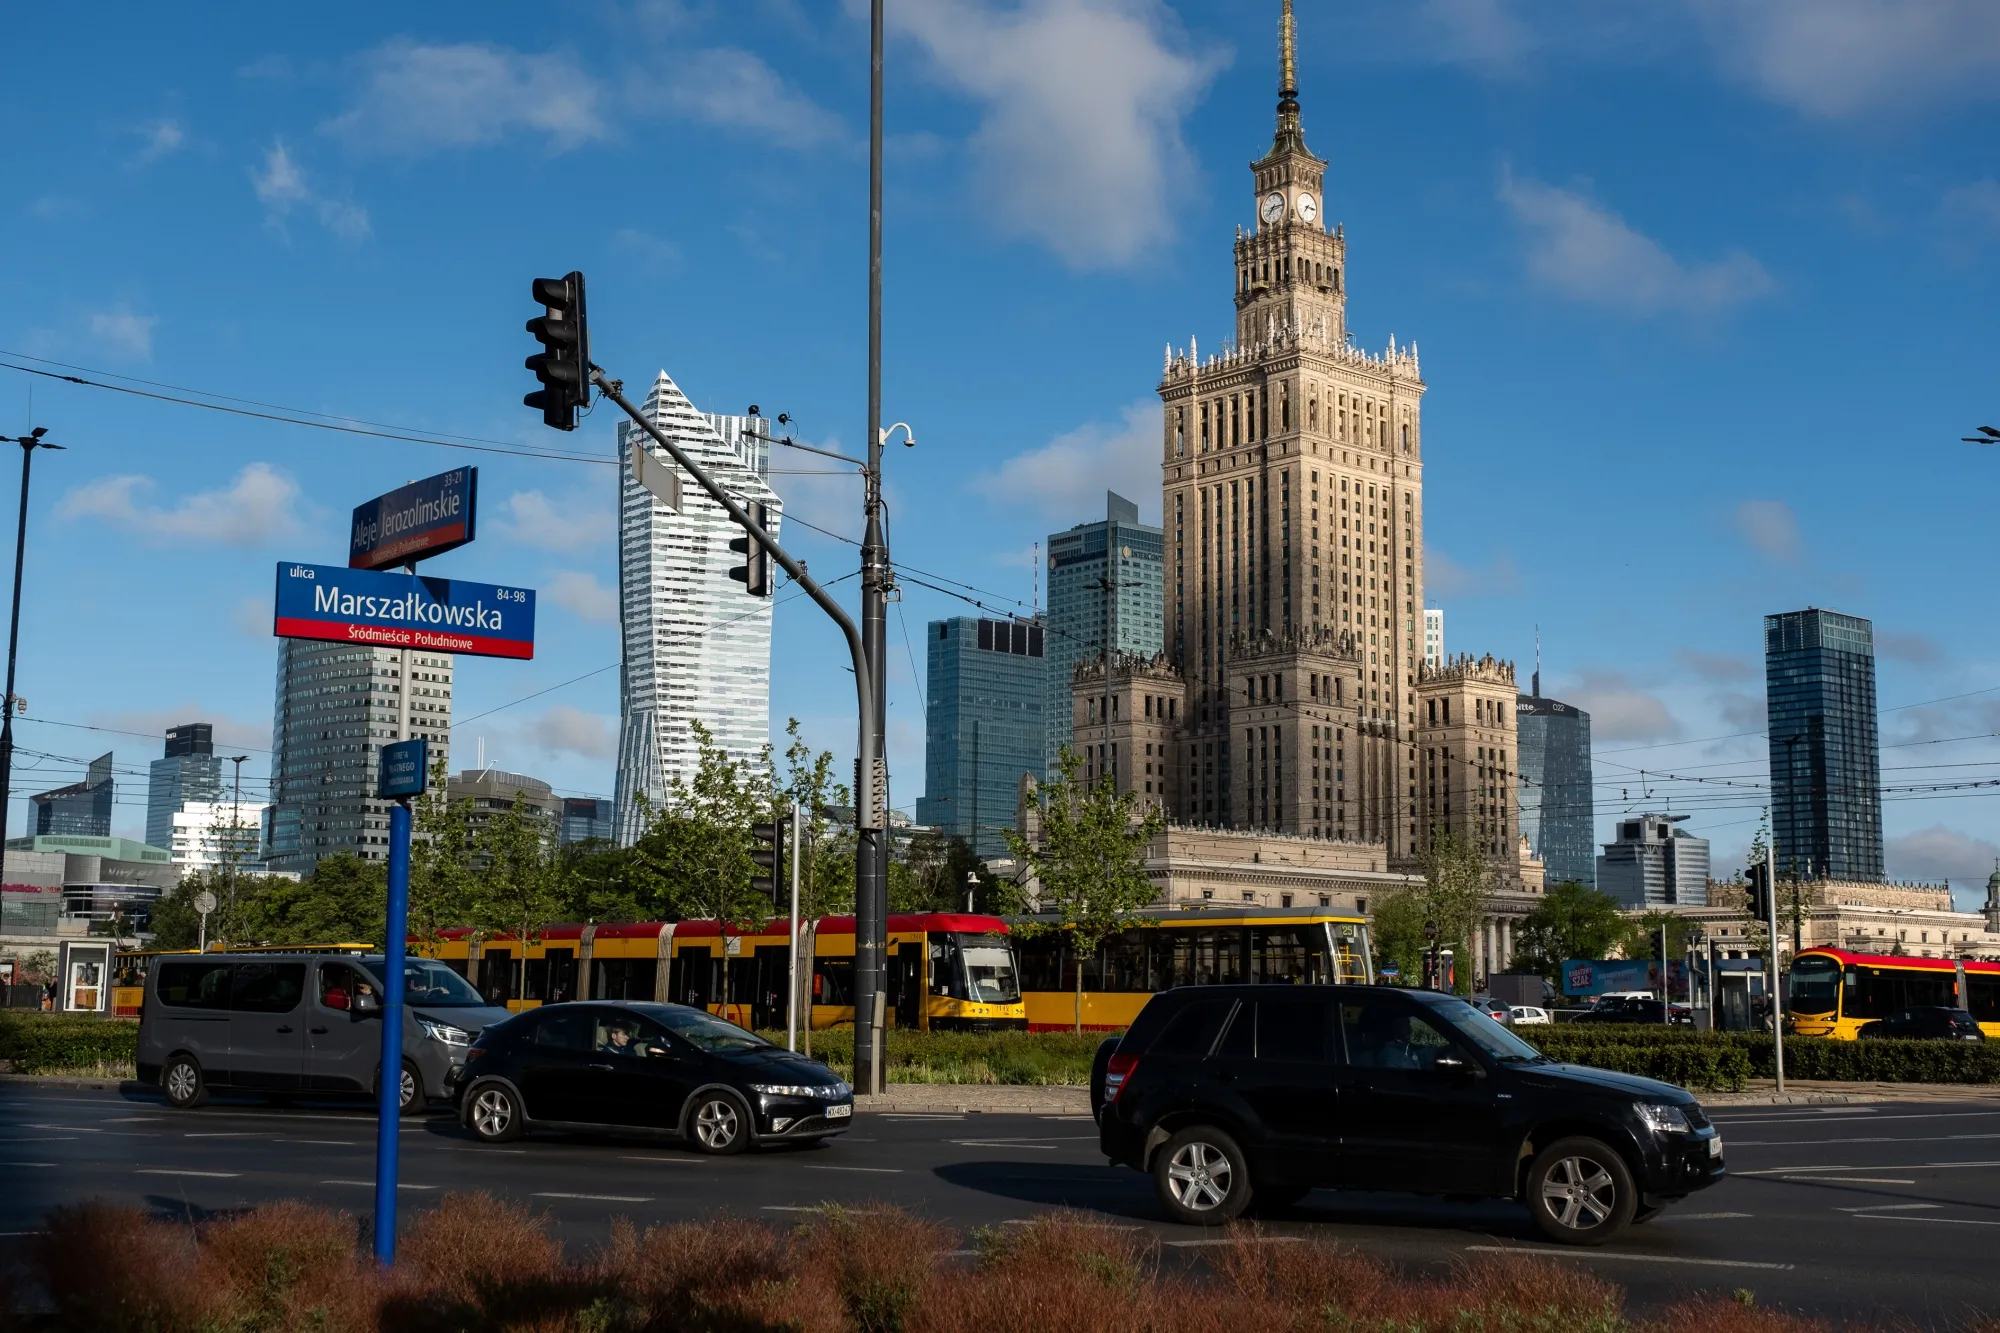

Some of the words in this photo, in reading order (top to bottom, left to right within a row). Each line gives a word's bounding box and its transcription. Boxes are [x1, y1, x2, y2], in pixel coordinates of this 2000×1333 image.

[353, 517, 377, 550] Aleje
[380, 489, 460, 537] Jerozolimskie
[290, 565, 315, 579] ulica
[314, 585, 502, 630] Marszałkowska
[497, 588, 526, 603] 84-98
[348, 624, 410, 644] Śródmieście
[415, 632, 473, 650] Południowe
